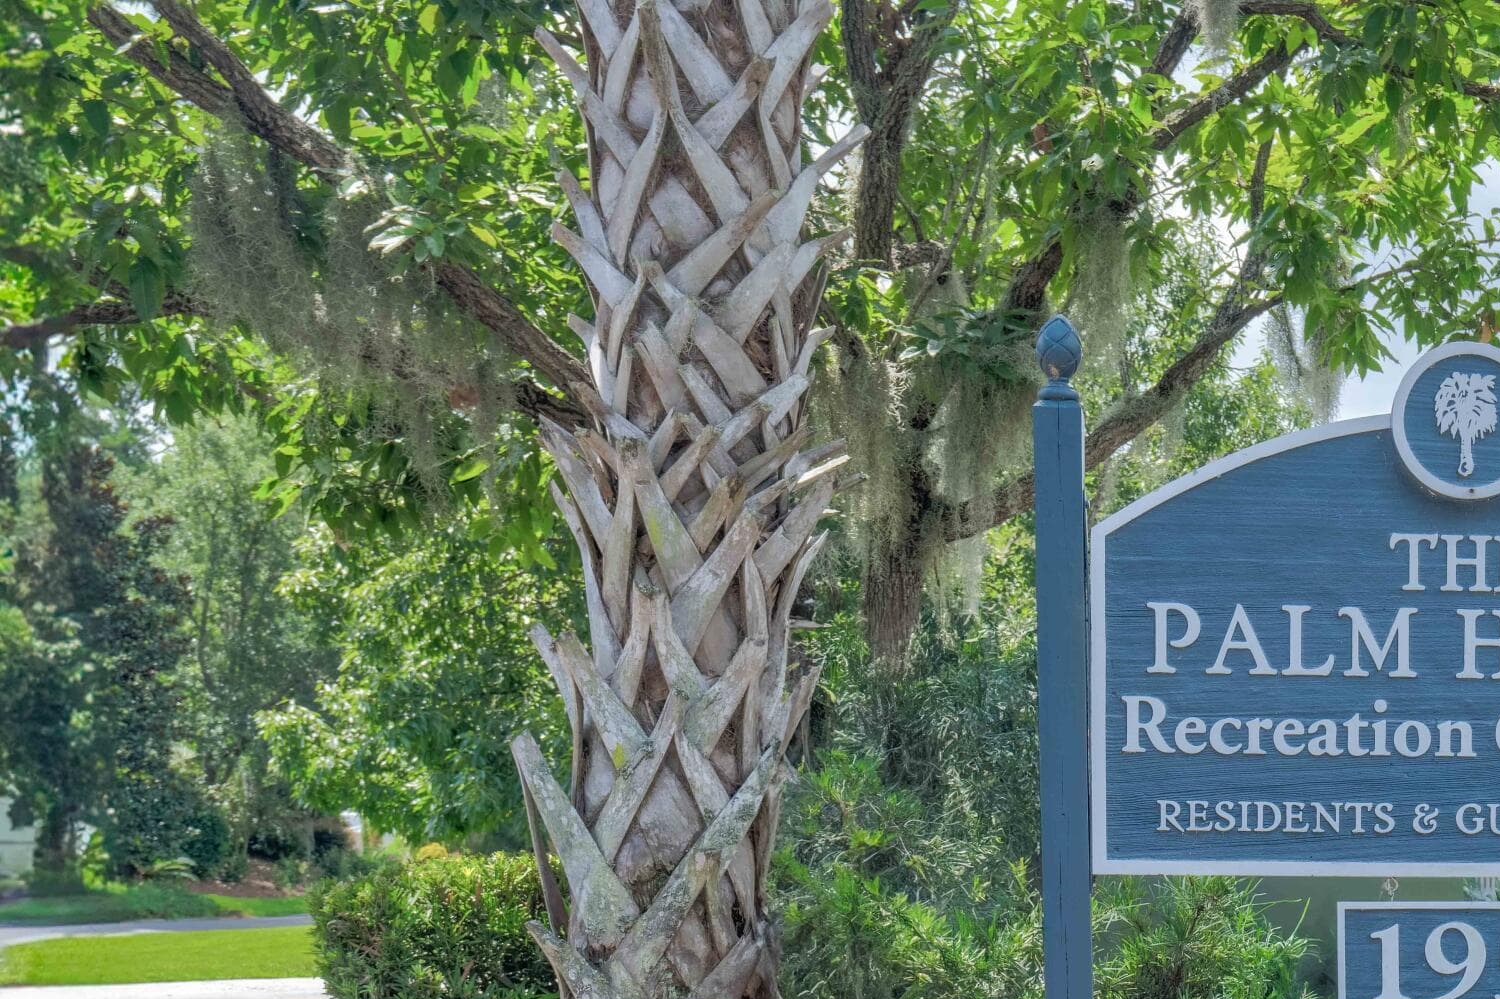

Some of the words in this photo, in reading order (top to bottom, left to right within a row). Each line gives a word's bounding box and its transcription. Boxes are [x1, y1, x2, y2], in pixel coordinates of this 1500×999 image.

[1146, 602, 1418, 678] PALM
[1121, 694, 1476, 760] Recreation
[1157, 800, 1394, 834] RESIDENTS
[1413, 804, 1438, 834] &
